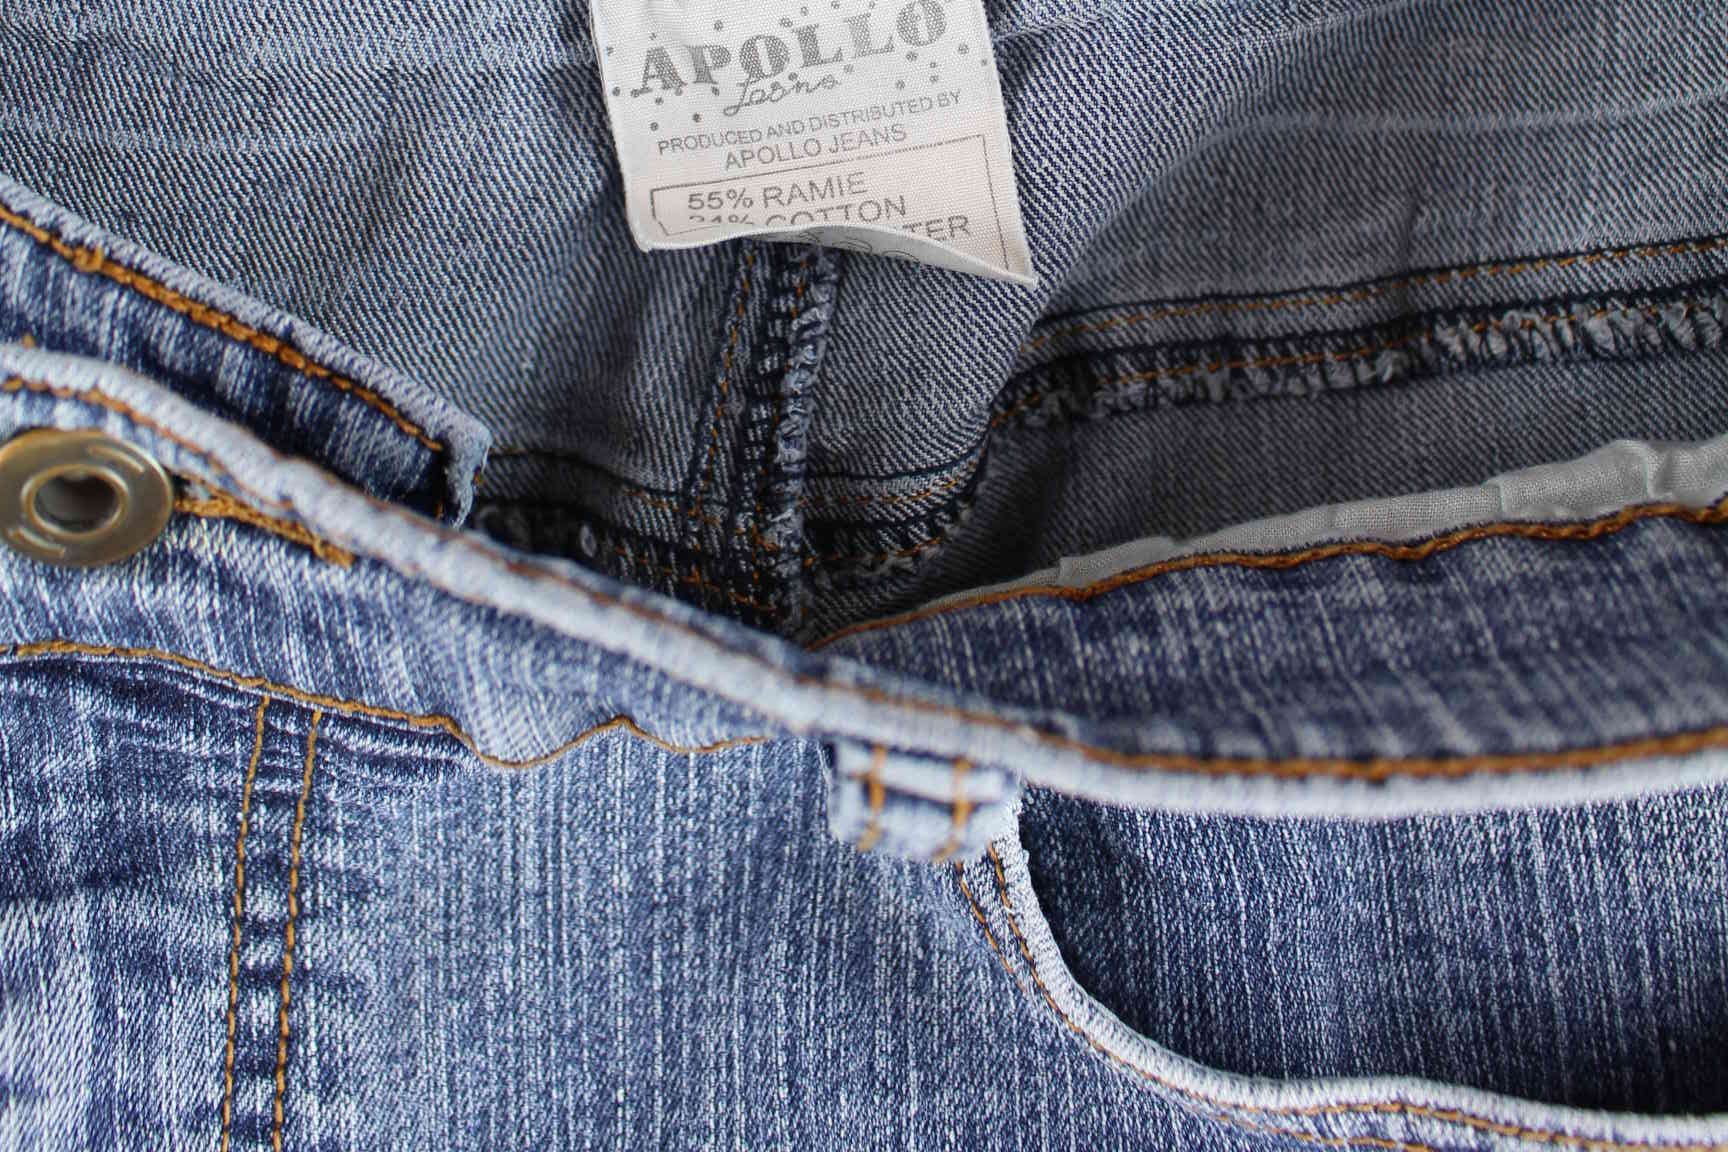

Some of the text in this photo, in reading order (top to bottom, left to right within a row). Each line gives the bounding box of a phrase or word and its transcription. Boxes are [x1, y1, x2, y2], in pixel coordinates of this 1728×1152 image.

[657, 88, 961, 156] PRODUCED AND DISTRIBUTED BY
[725, 123, 908, 172] APOLLO JEANS
[686, 171, 869, 211] 55% RAMIE
